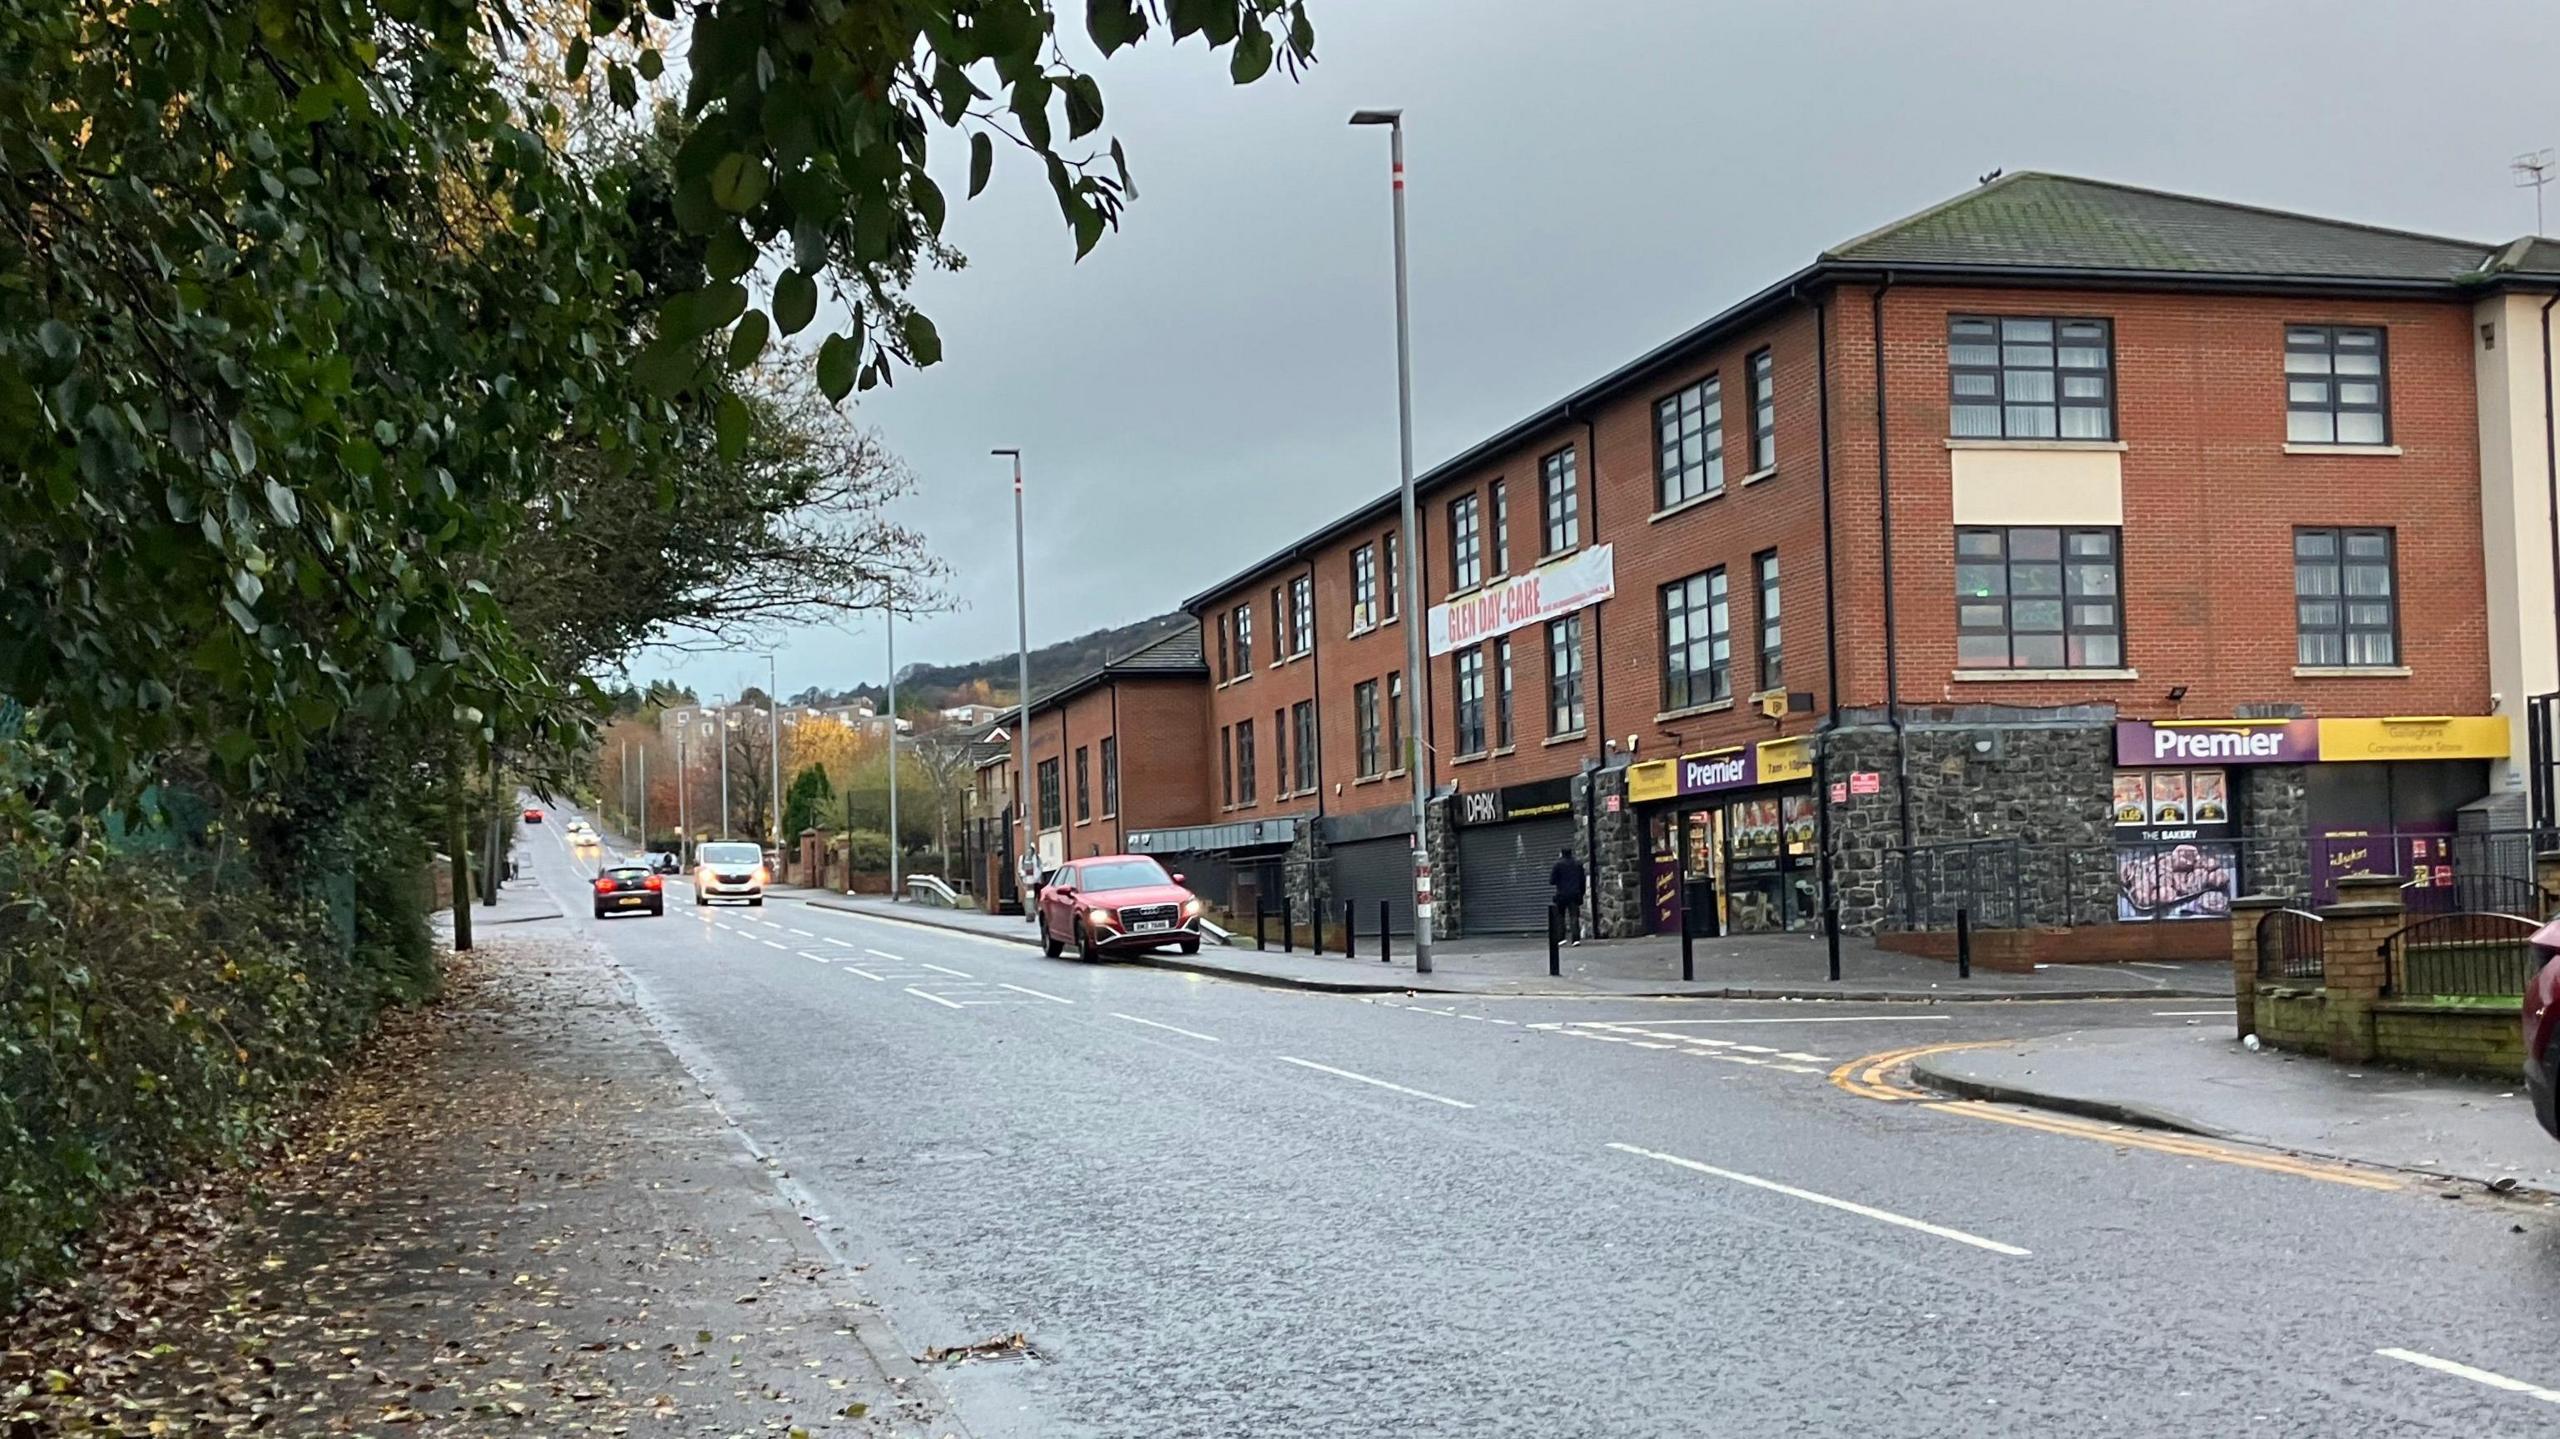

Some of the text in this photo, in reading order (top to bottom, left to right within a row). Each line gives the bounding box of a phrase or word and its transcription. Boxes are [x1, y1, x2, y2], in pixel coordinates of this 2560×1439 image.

[1448, 599, 1475, 643] GLEN
[2154, 729, 2284, 759] Premier
[1686, 758, 1746, 789] Premier
[1466, 792, 1496, 822] DARK
[2142, 829, 2198, 840] THE BAKERY
